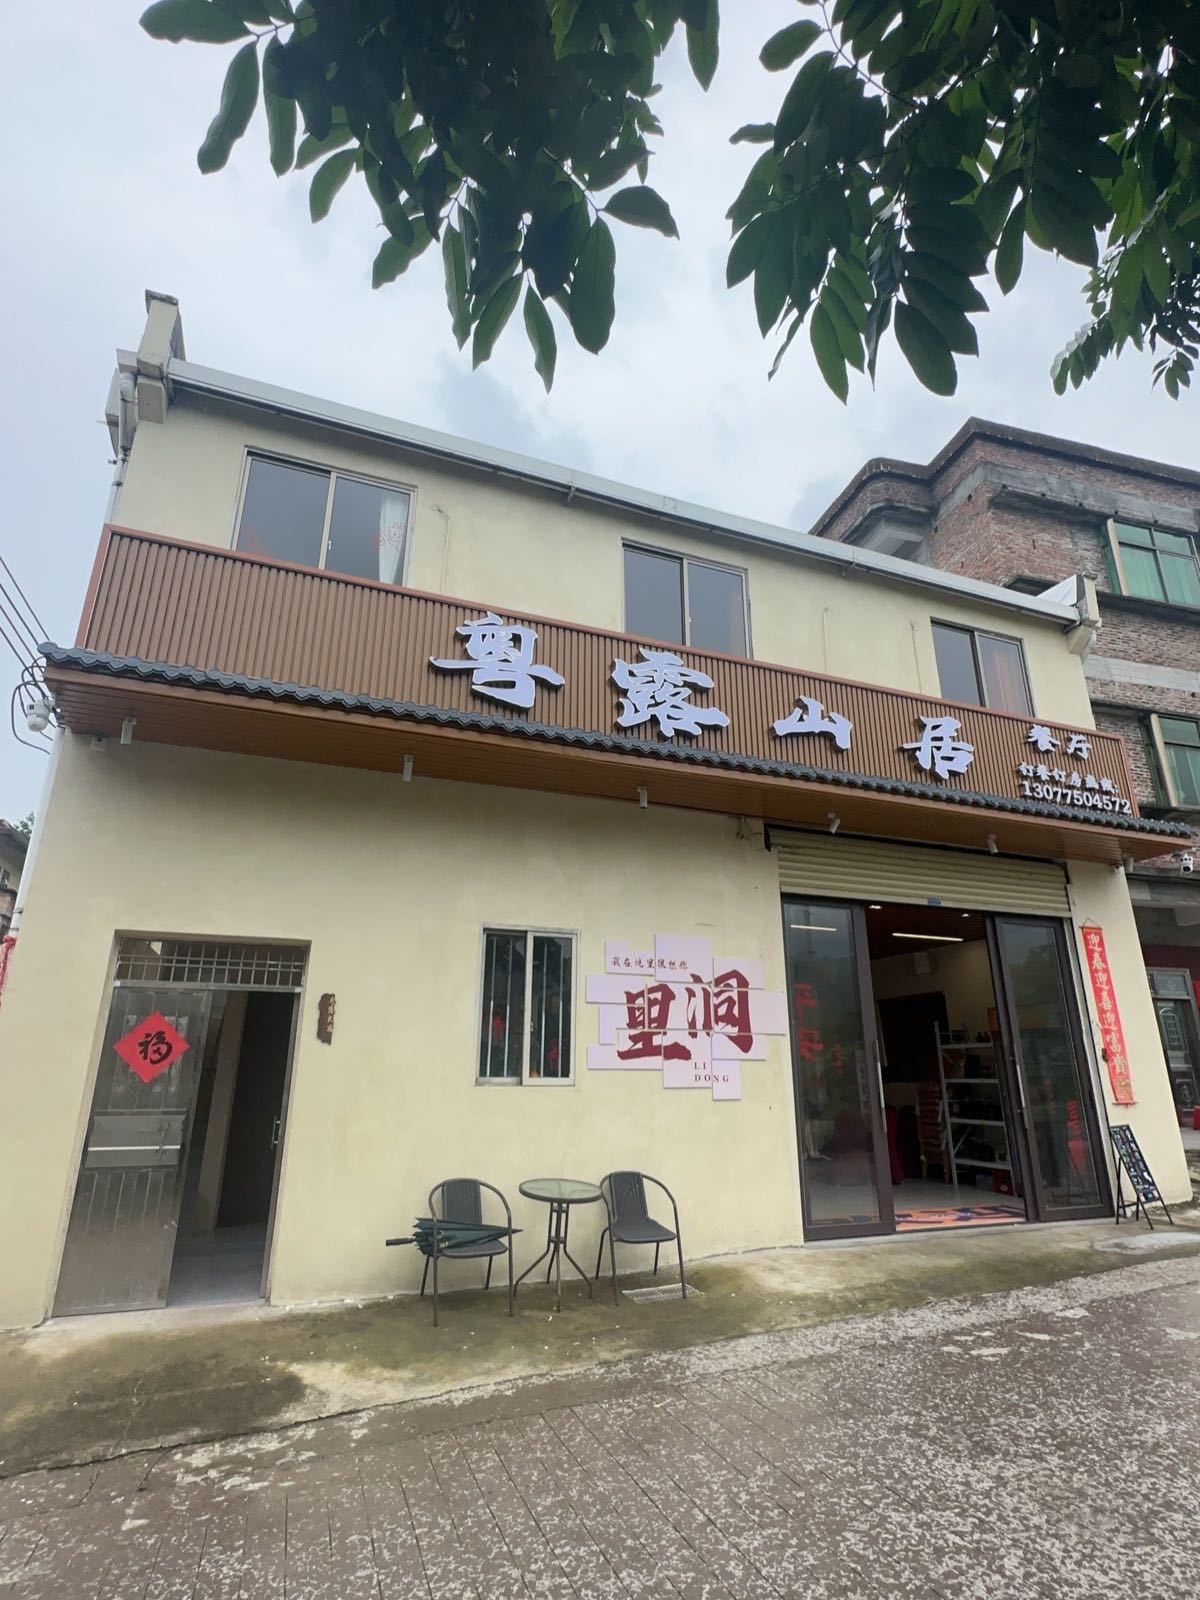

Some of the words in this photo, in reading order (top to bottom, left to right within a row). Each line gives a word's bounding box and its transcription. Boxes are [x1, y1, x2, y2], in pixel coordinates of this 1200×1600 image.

[1027, 724, 1092, 760] 餐厅
[1022, 781, 1132, 814] 13077504572
[611, 956, 689, 970] 我在这里很想你
[617, 969, 754, 1060] 里洞
[138, 1030, 172, 1065] 福
[694, 1062, 706, 1070] LI
[694, 1073, 729, 1082] DONG
